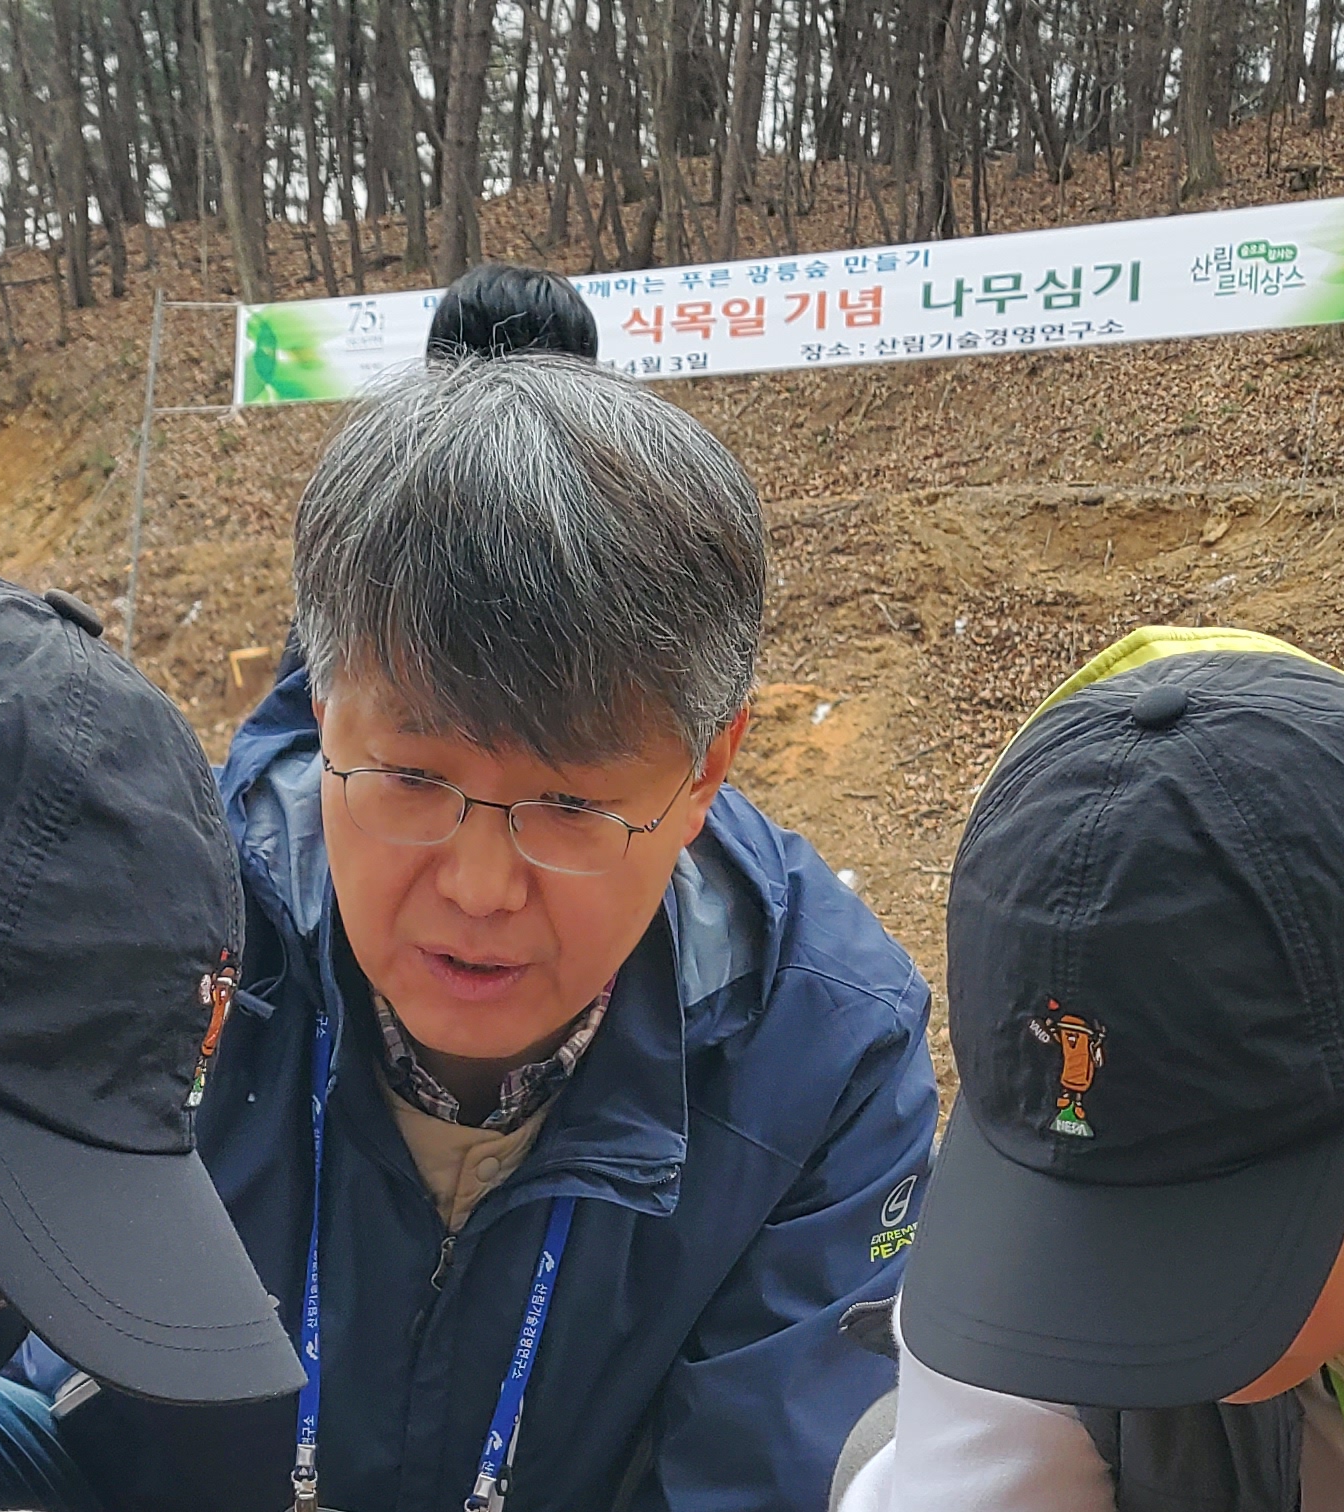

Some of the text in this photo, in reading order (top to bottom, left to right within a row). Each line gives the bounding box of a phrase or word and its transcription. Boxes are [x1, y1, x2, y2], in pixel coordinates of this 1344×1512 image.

[679, 268, 732, 290] 푸른
[746, 259, 830, 285] 광릉숲
[844, 249, 930, 274] 만들기
[1191, 243, 1233, 282] 산림
[1214, 262, 1306, 296] 르네상스
[922, 260, 1141, 318] 나무심기
[669, 352, 708, 372] 3일
[874, 319, 1125, 356] 산림기술경영연구소
[1056, 1119, 1087, 1136] NEPA
[870, 1233, 915, 1262] PEA
[512, 1283, 548, 1379] 산림기술경영연구소
